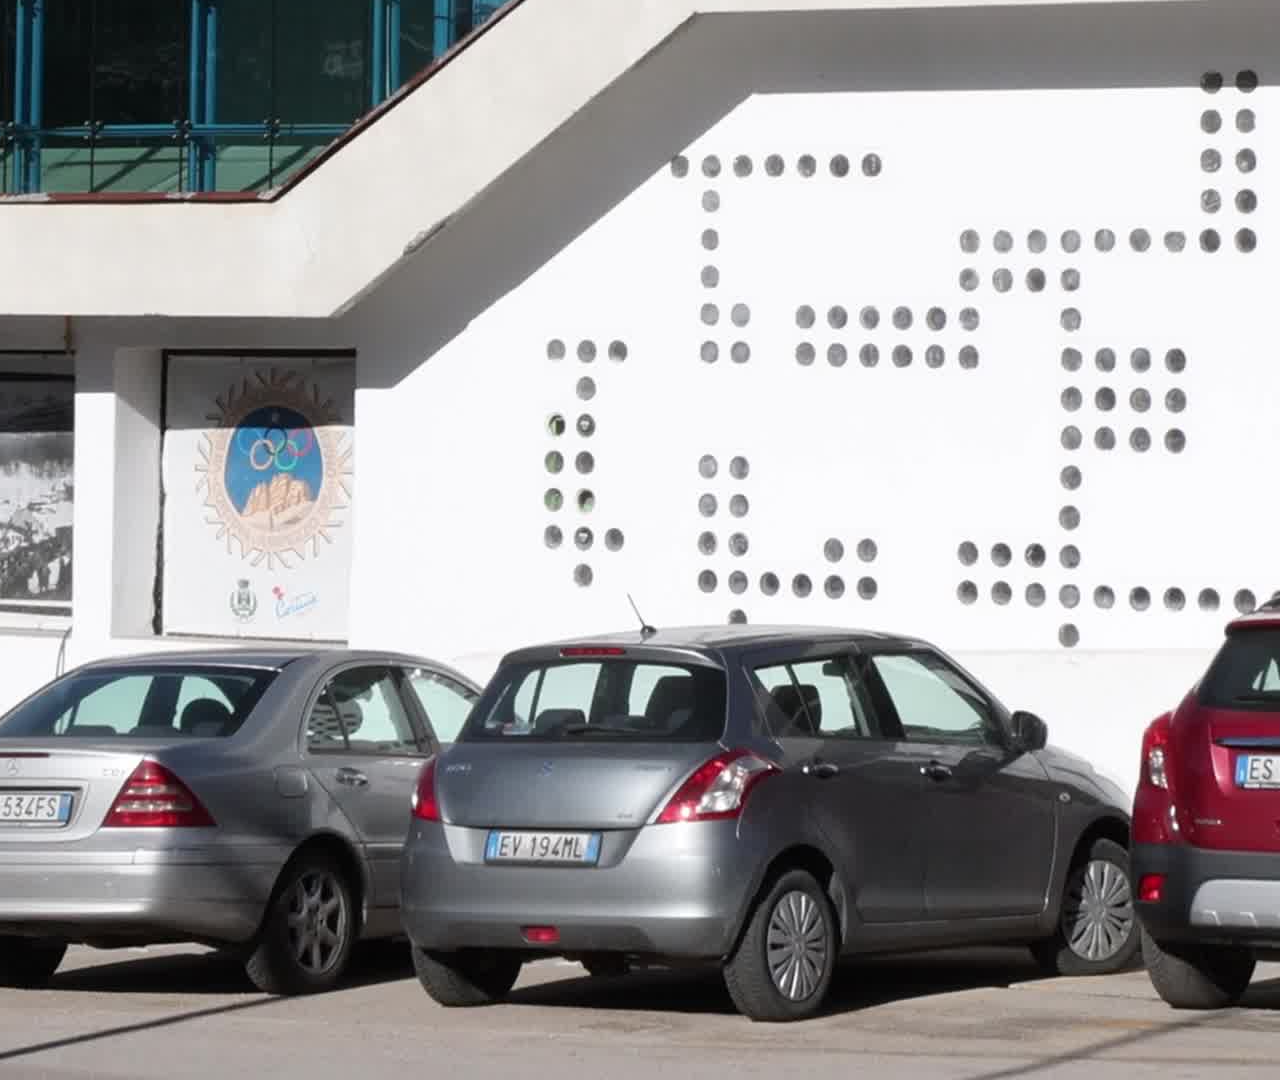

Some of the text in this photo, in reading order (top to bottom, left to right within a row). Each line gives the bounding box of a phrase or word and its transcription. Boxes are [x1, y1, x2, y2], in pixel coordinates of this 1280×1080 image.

[1249, 758, 1273, 781] ES
[2, 796, 58, 818] 534FS
[498, 835, 583, 859] EV 194ML
